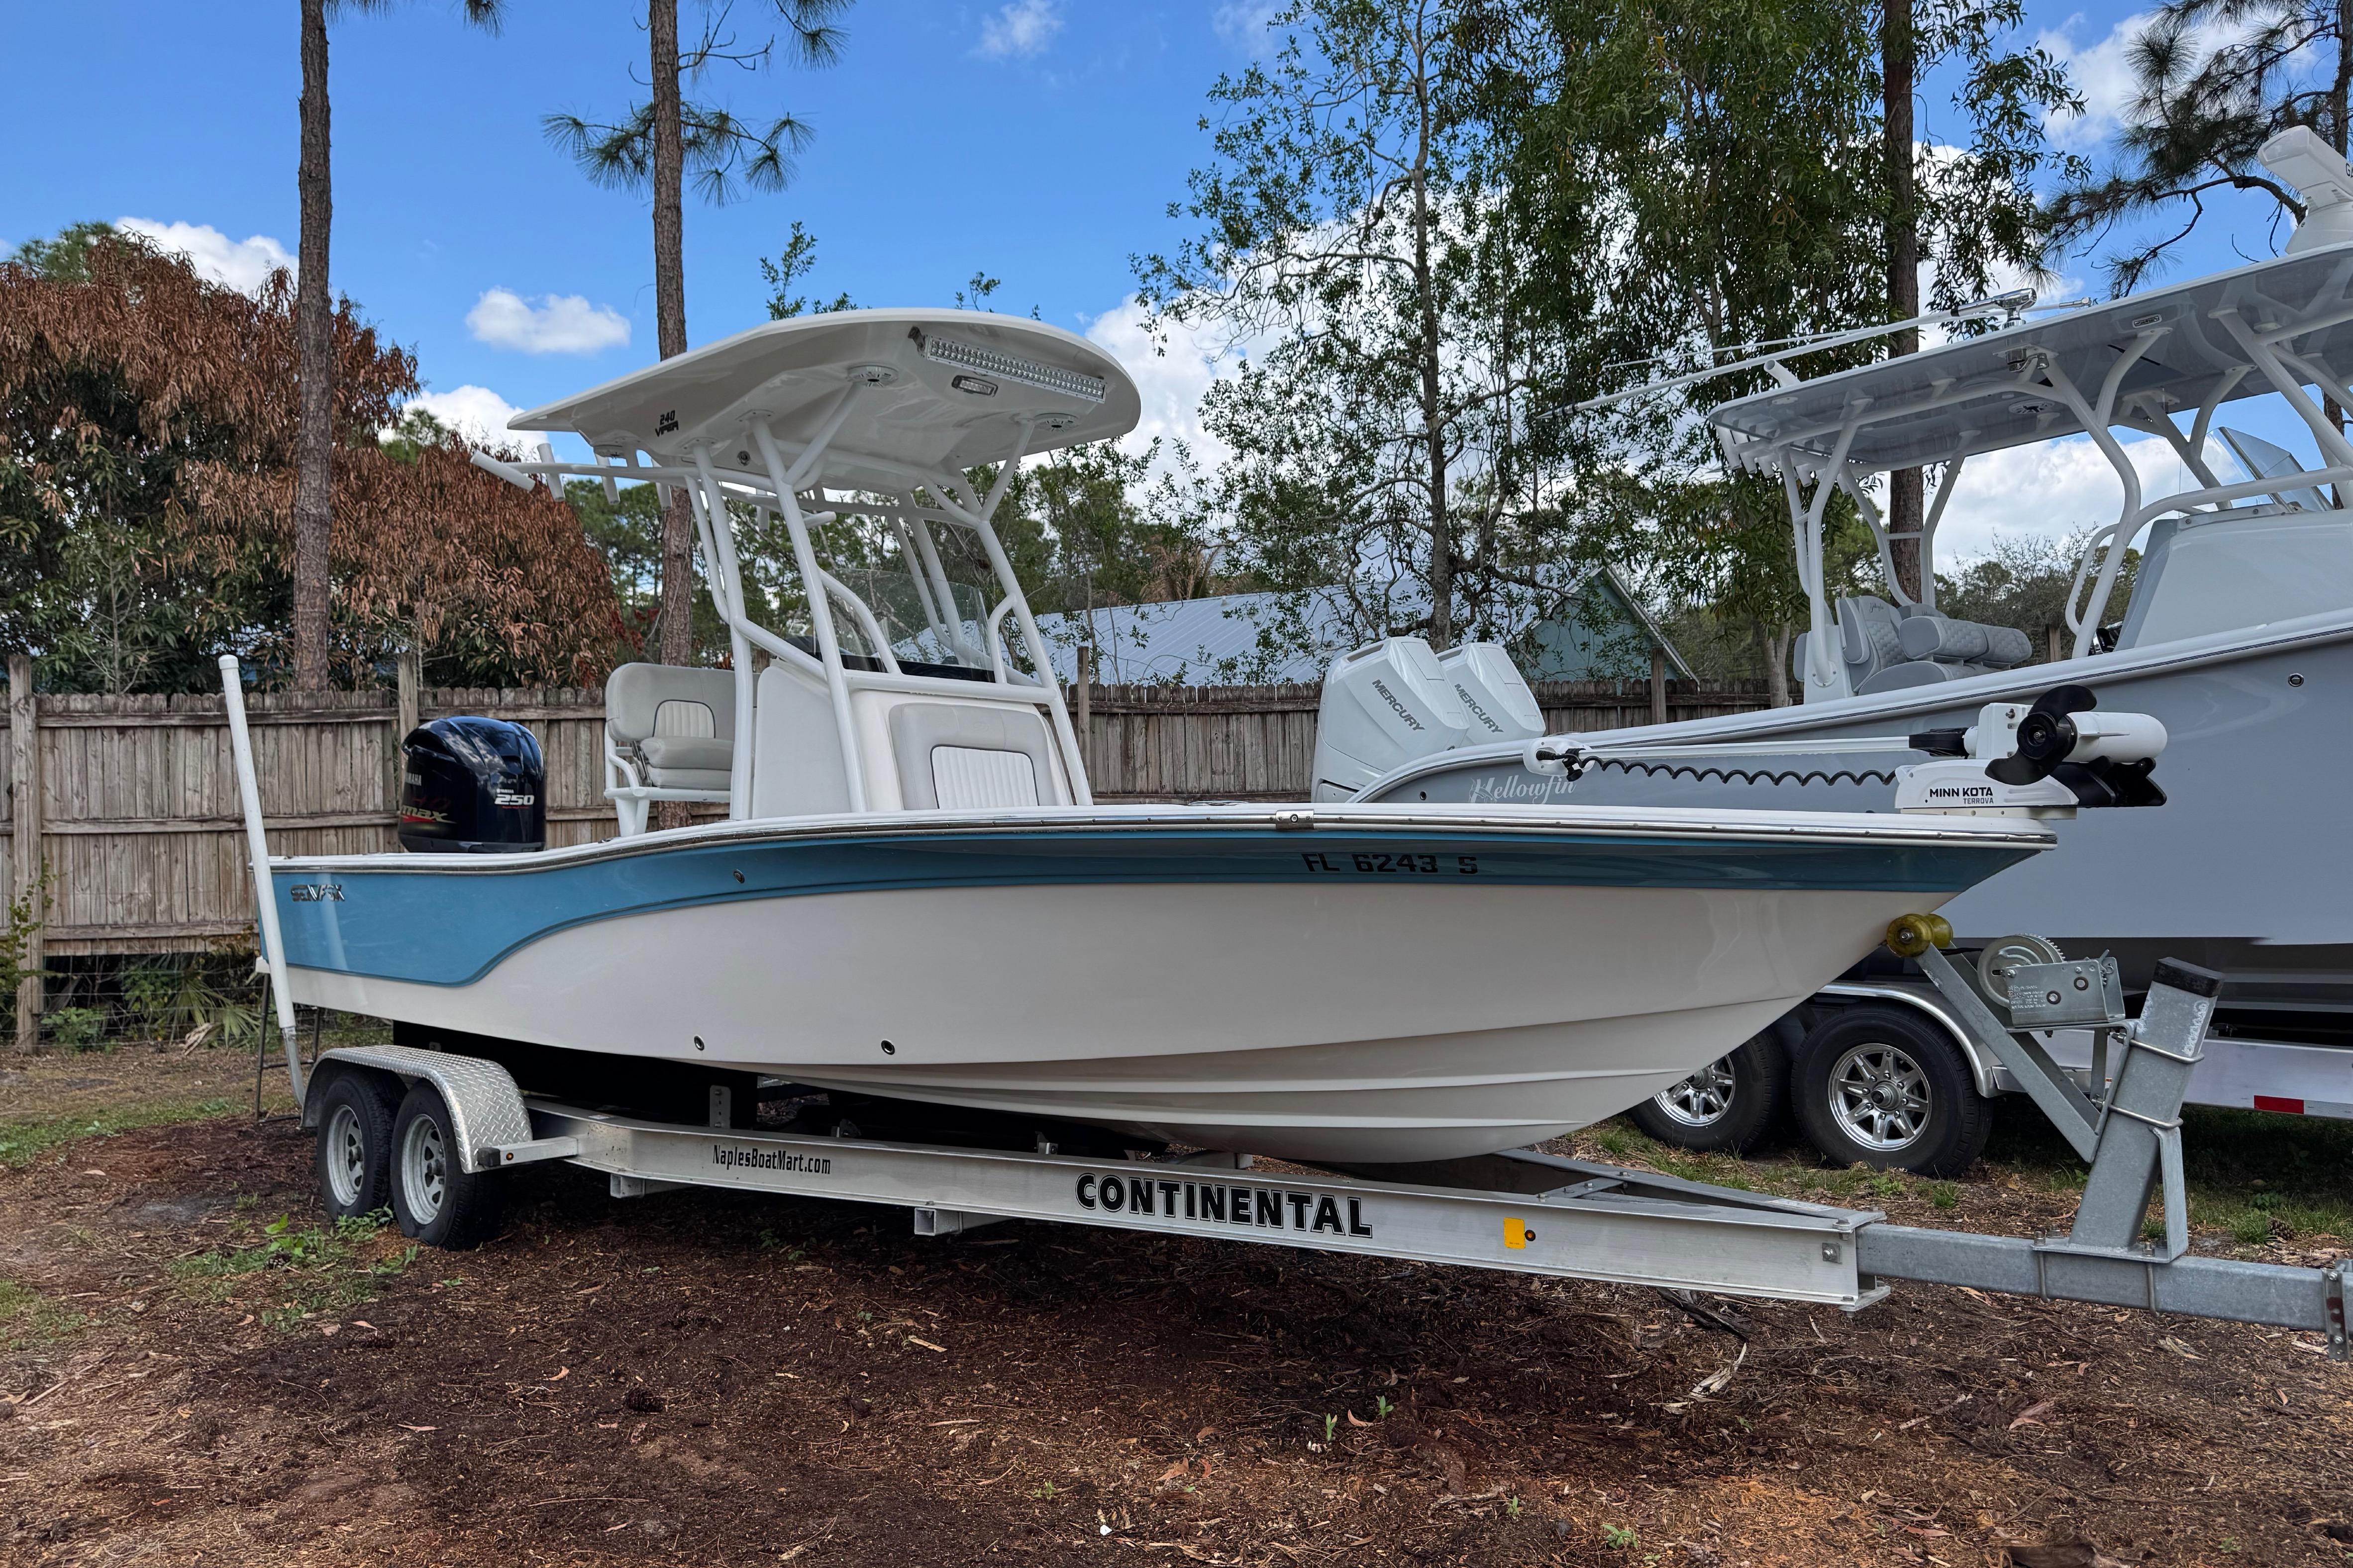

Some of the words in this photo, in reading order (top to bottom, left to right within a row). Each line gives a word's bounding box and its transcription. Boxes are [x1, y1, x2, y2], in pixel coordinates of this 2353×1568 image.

[660, 410, 675, 425] 240
[1371, 679, 1425, 731] MERCURY
[1454, 684, 1505, 734] MERCURY
[494, 794, 534, 805] 250
[1930, 787, 1959, 797] MINN
[1962, 787, 1993, 796] KOTA
[1301, 853, 1340, 872] FL
[1351, 853, 1438, 873] 6243
[1457, 856, 1478, 874] S
[713, 1145, 831, 1175] NaplesBoatMart.com
[1075, 1173, 1373, 1239] CONTINENTAL
